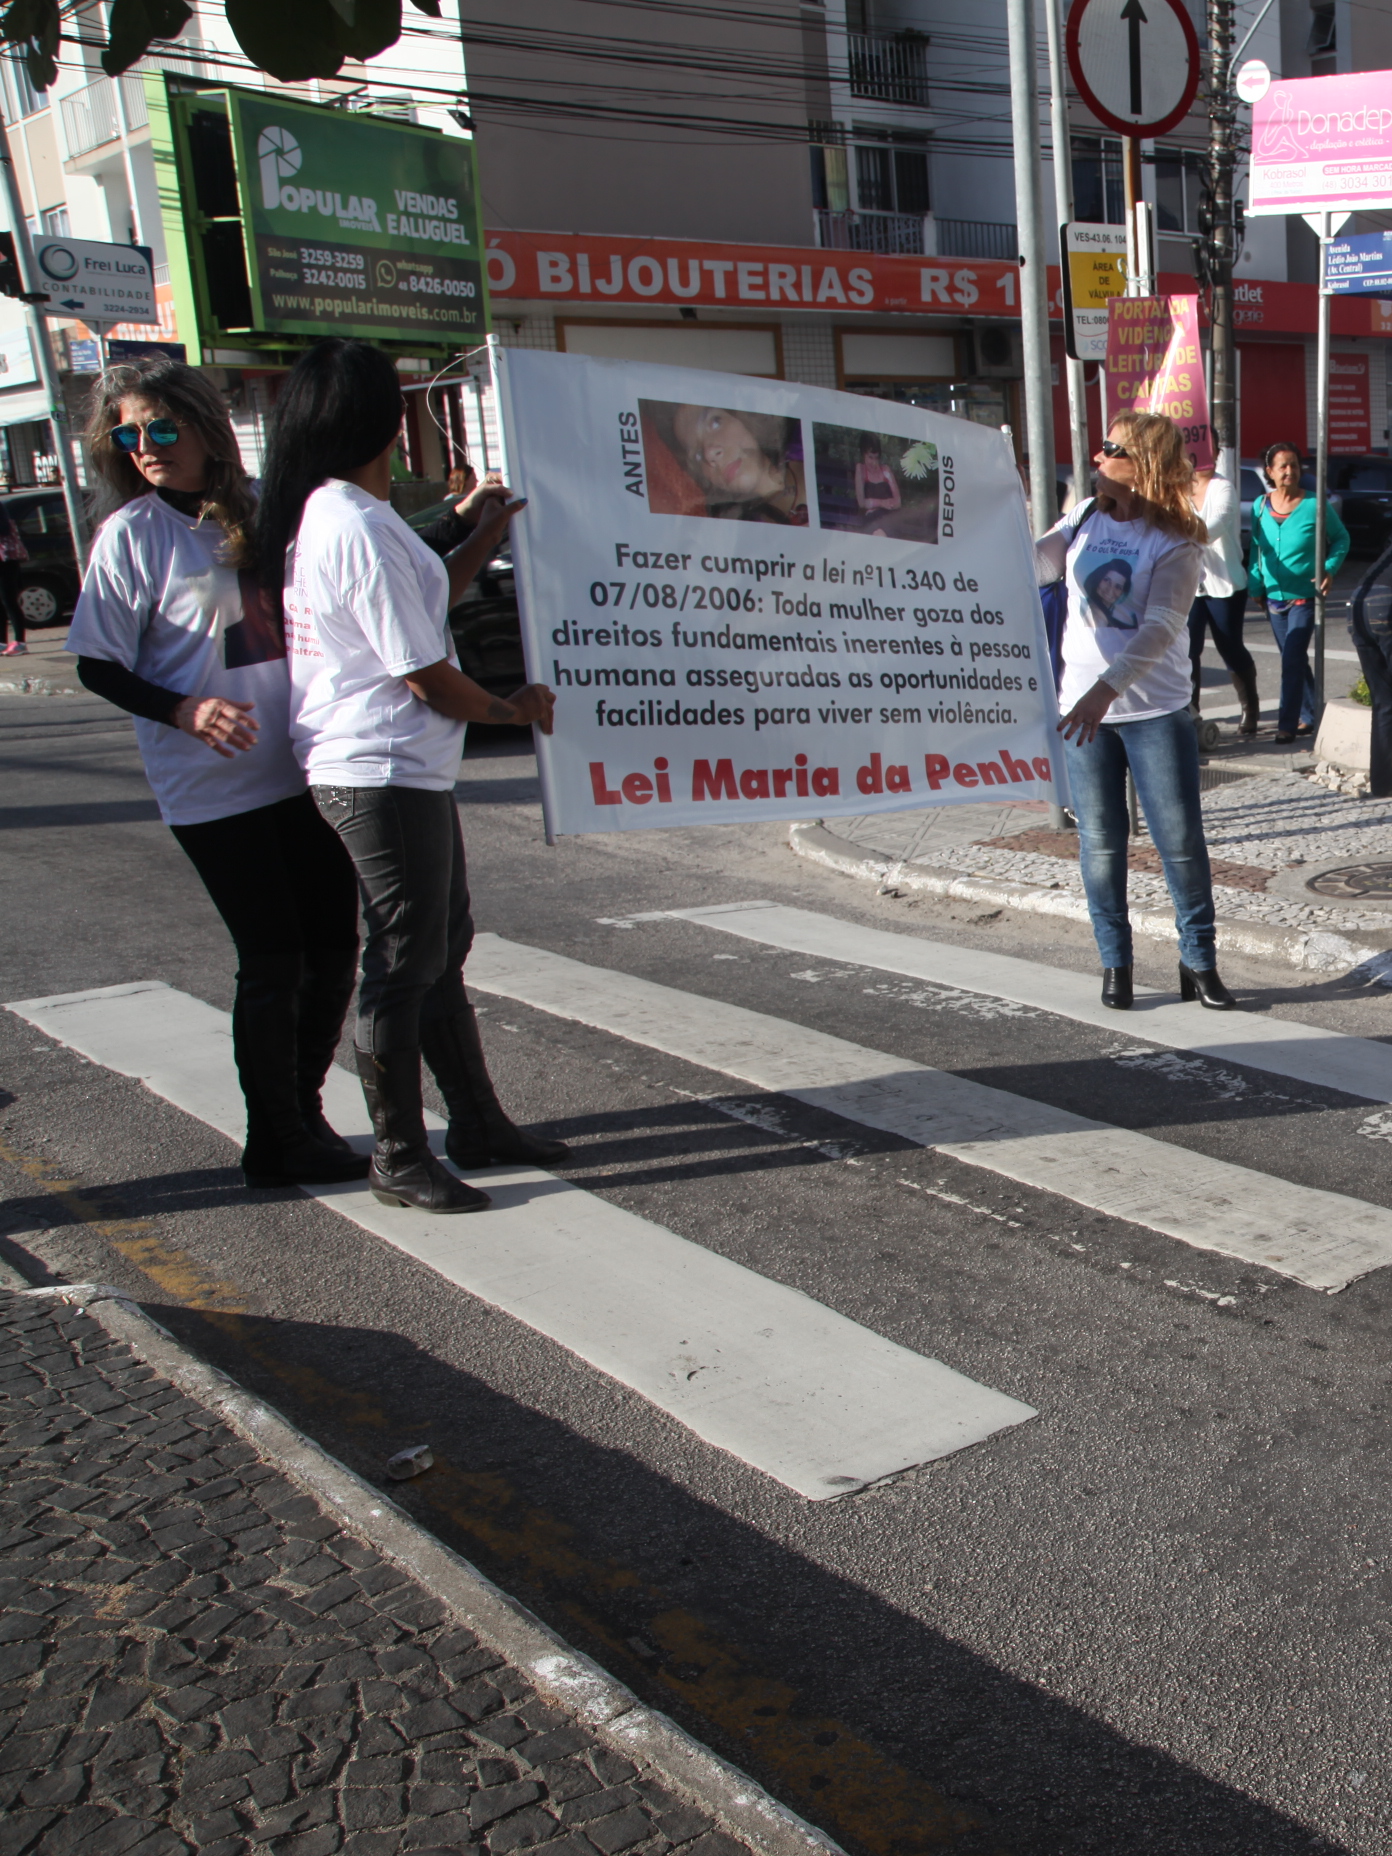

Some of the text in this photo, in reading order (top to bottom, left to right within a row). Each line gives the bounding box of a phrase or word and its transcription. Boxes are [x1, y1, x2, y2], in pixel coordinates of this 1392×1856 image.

[1263, 167, 1306, 181] Kobrasol
[1324, 166, 1339, 174] SEM
[1340, 164, 1361, 173] HORA
[1341, 177, 1368, 189] 3034
[394, 189, 458, 219] VENDAS
[386, 214, 470, 245] E ALUGUEL
[300, 248, 365, 269] 3259-3259
[1328, 244, 1351, 254] Avenida
[1359, 251, 1383, 262] Martins
[84, 257, 112, 271] Frei
[115, 261, 146, 275] Luca
[303, 268, 366, 289] 3242-0015
[409, 275, 475, 297] 8426-0050
[536, 251, 873, 305] BIJOUTERIAS
[920, 267, 979, 309] R$
[1098, 276, 1110, 285] DE
[42, 283, 151, 301] CONTABILIDADE
[103, 304, 150, 315] 3224-2934
[272, 294, 477, 324] www.popularimoveis.com.br
[1113, 298, 1189, 320] PORTAL DA
[1176, 345, 1197, 365] DE
[618, 411, 645, 498] ANTES
[942, 455, 955, 538] DEPOIS
[615, 542, 692, 571] Fazer
[700, 553, 796, 582] cumprir
[803, 563, 815, 581] a
[823, 558, 845, 584] lei
[953, 571, 979, 593] de
[589, 581, 1004, 628] 07/08/2006: Toda mulher goza dos
[552, 619, 1031, 662] direitos fundamentais inerentes à pessoa
[553, 659, 1038, 694] humana asseguradas as oportunidades e
[595, 699, 1018, 731] facilidades para viver sem violência.
[588, 749, 1052, 806] Lei Maria da Penha
